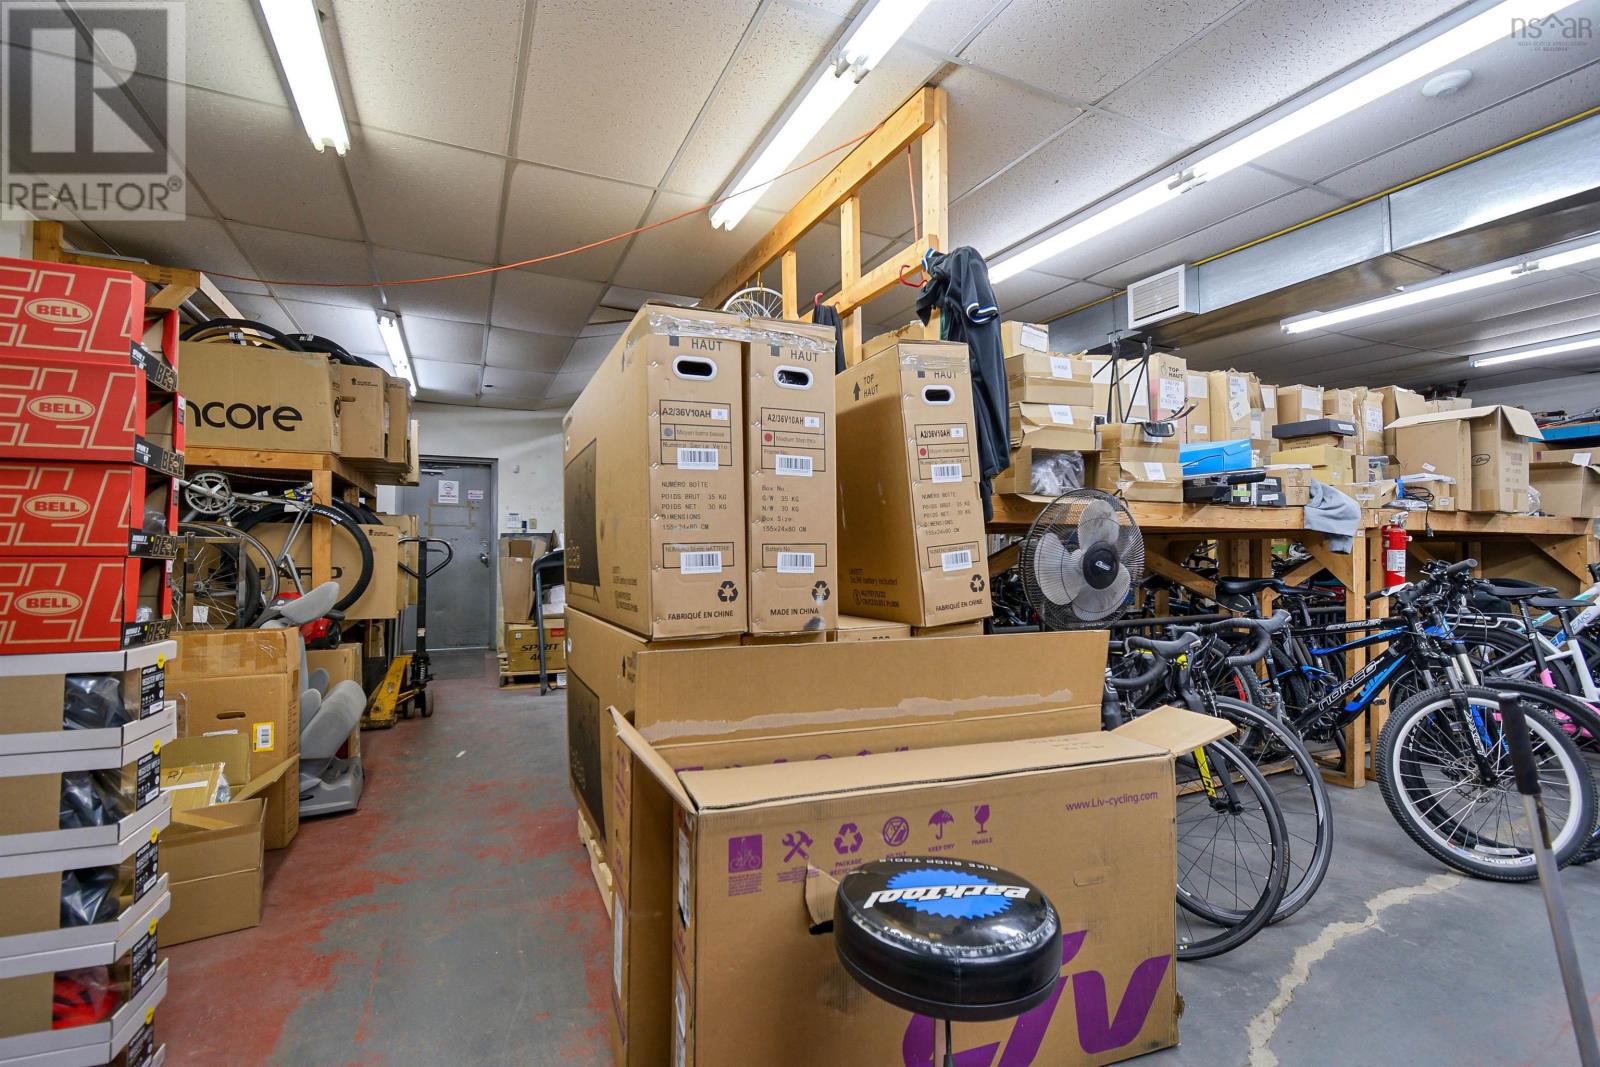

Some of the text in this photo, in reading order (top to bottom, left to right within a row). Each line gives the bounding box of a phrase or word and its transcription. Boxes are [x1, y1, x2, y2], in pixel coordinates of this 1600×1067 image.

[36, 304, 82, 318] BELL
[691, 338, 723, 351] HAUT
[790, 349, 819, 362] HAUT
[863, 373, 875, 384] TOP
[863, 384, 879, 397] HAUT
[39, 402, 85, 415] BELL
[662, 407, 711, 419] A2/36V10AH
[767, 414, 804, 426] A2/36V10AH
[34, 501, 80, 513] BELL
[26, 598, 72, 609] BELL
[668, 610, 701, 621] FABRIQUÉ
[714, 610, 734, 618] CHINE
[770, 608, 790, 616] MADE
[791, 608, 798, 616] IN
[1065, 791, 1158, 811] www.Liv-cycling.com
[835, 858, 862, 868] PACKAGE
[863, 885, 1031, 909] ParkTool
